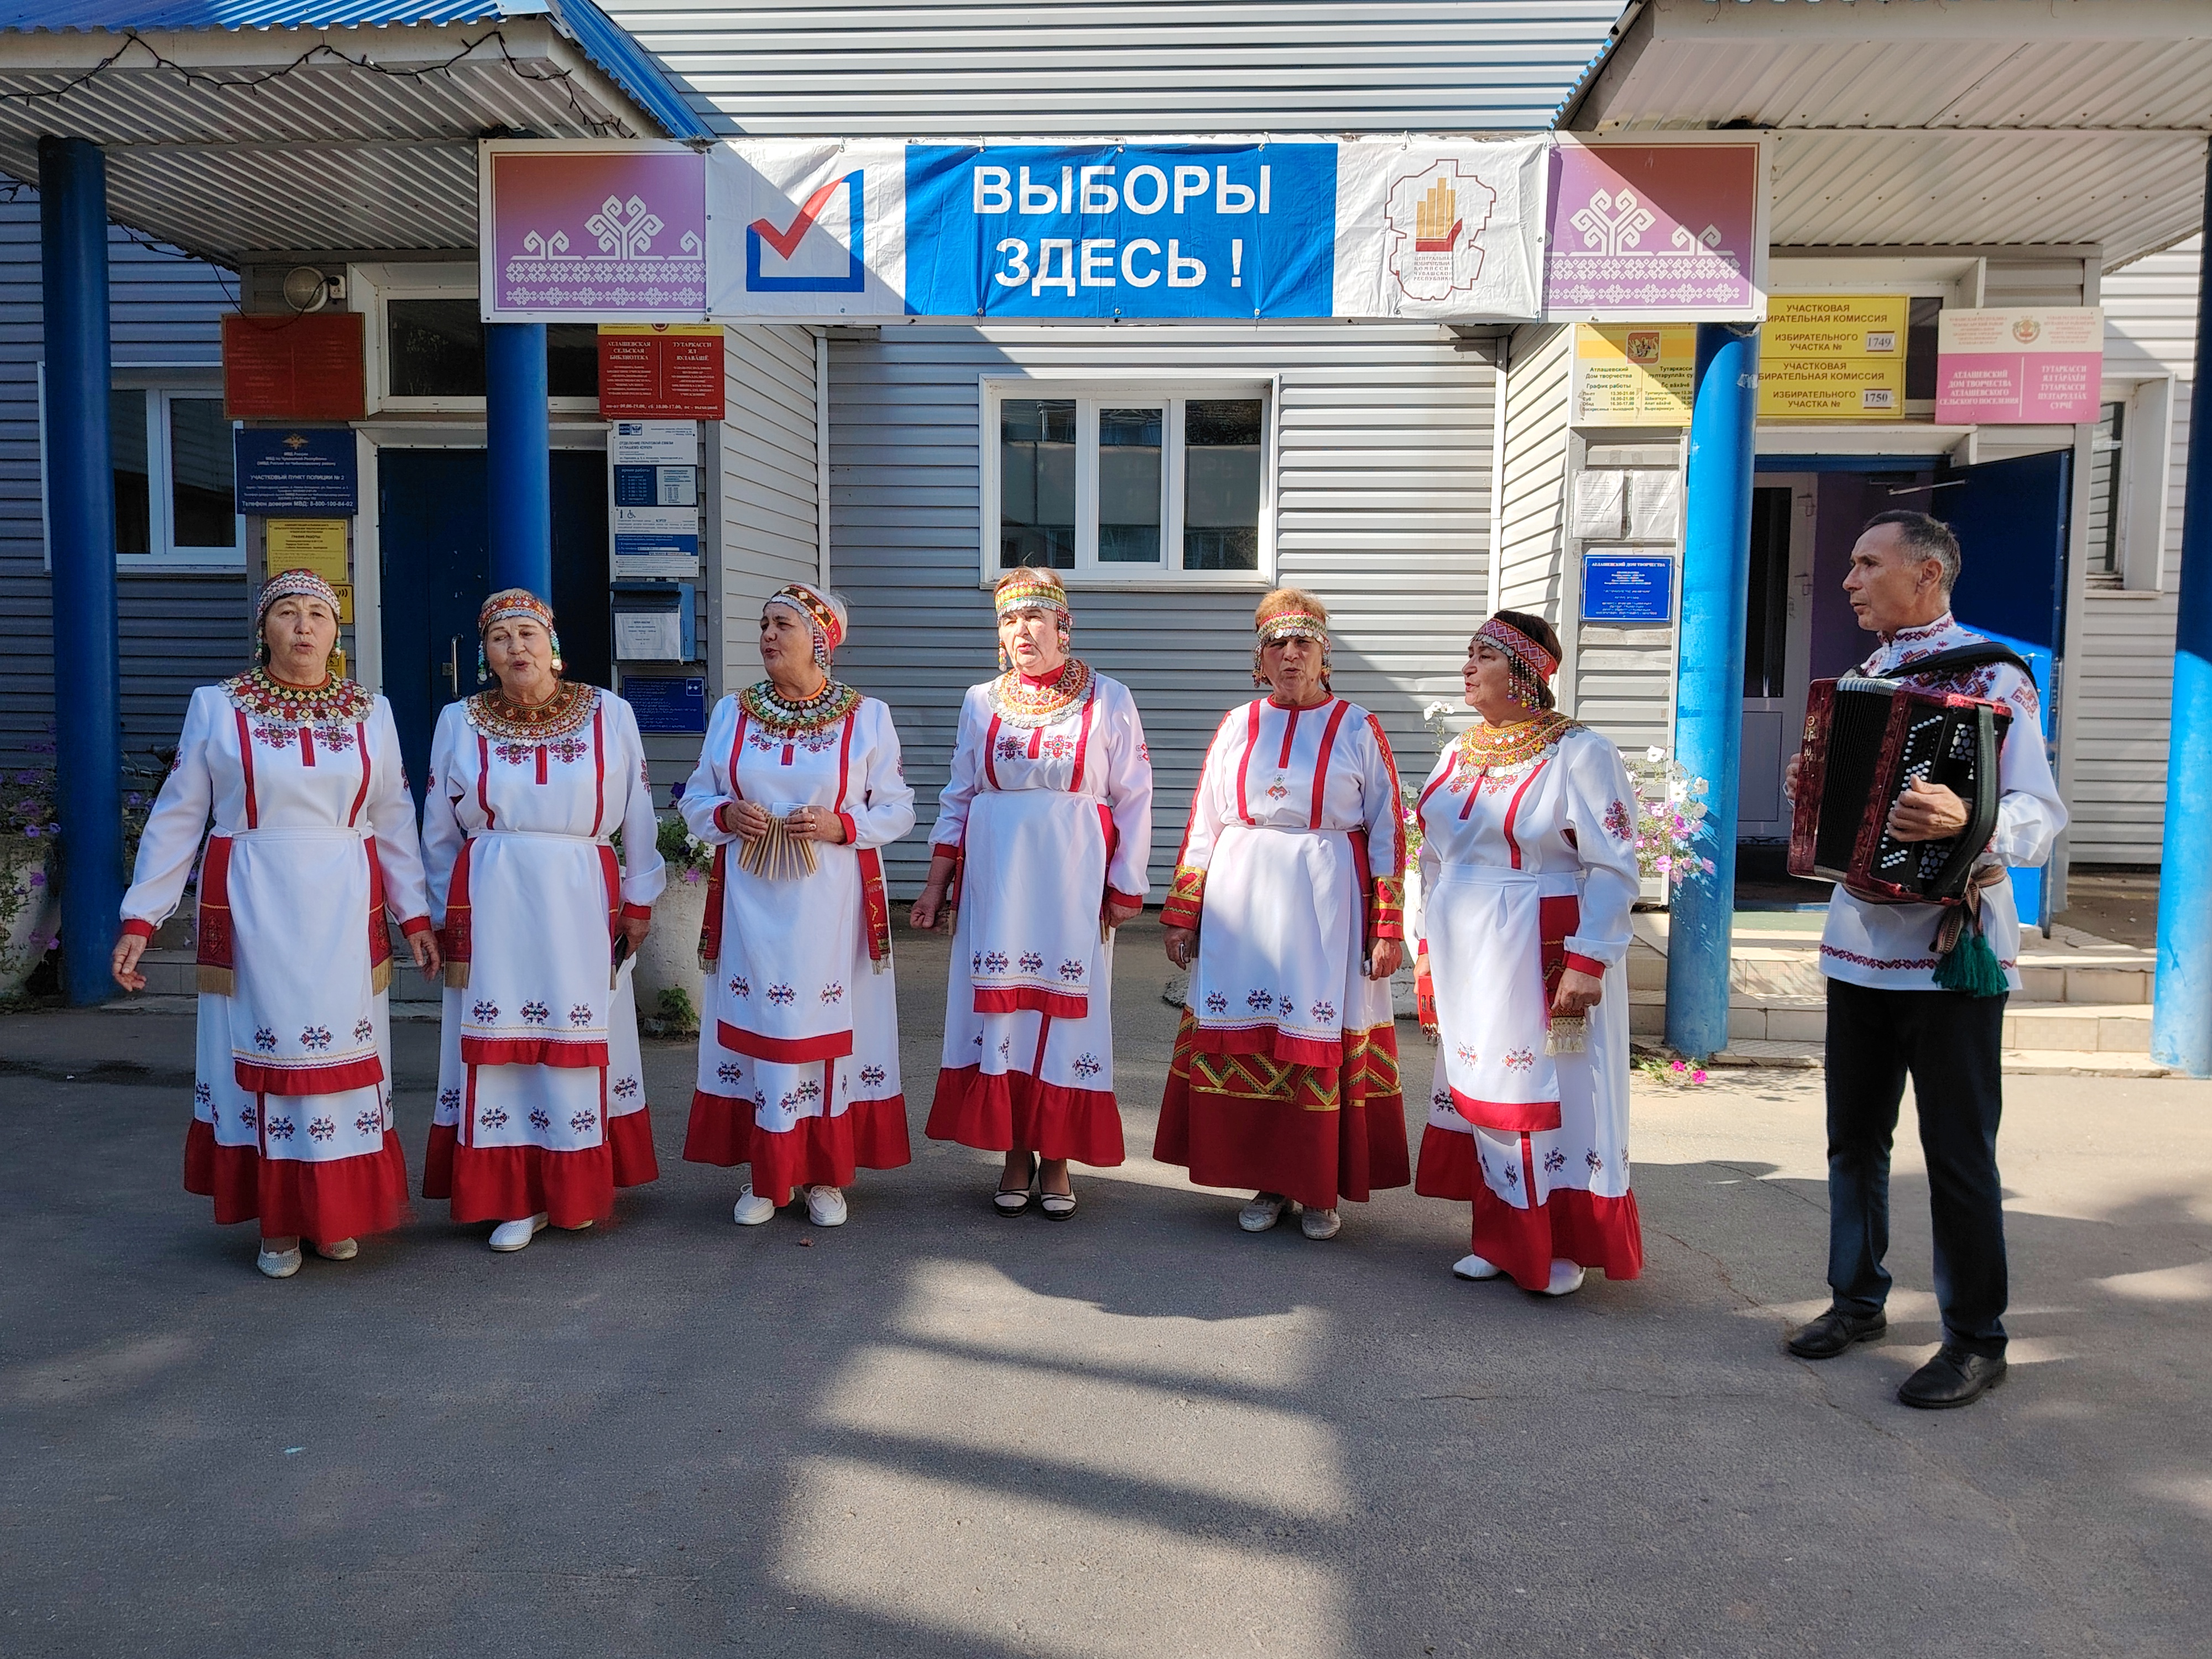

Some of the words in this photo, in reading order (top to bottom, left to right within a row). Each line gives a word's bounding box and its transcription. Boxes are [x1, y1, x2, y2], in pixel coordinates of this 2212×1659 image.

[973, 165, 1270, 215] ВЫБОРЫ
[995, 238, 1207, 297] ЗДЕСЬ
[1231, 238, 1243, 288] !
[1868, 337, 1891, 347] 1749
[1953, 370, 2008, 378] АТЛАШЕВСКИЙ
[1865, 393, 1888, 402] 1750
